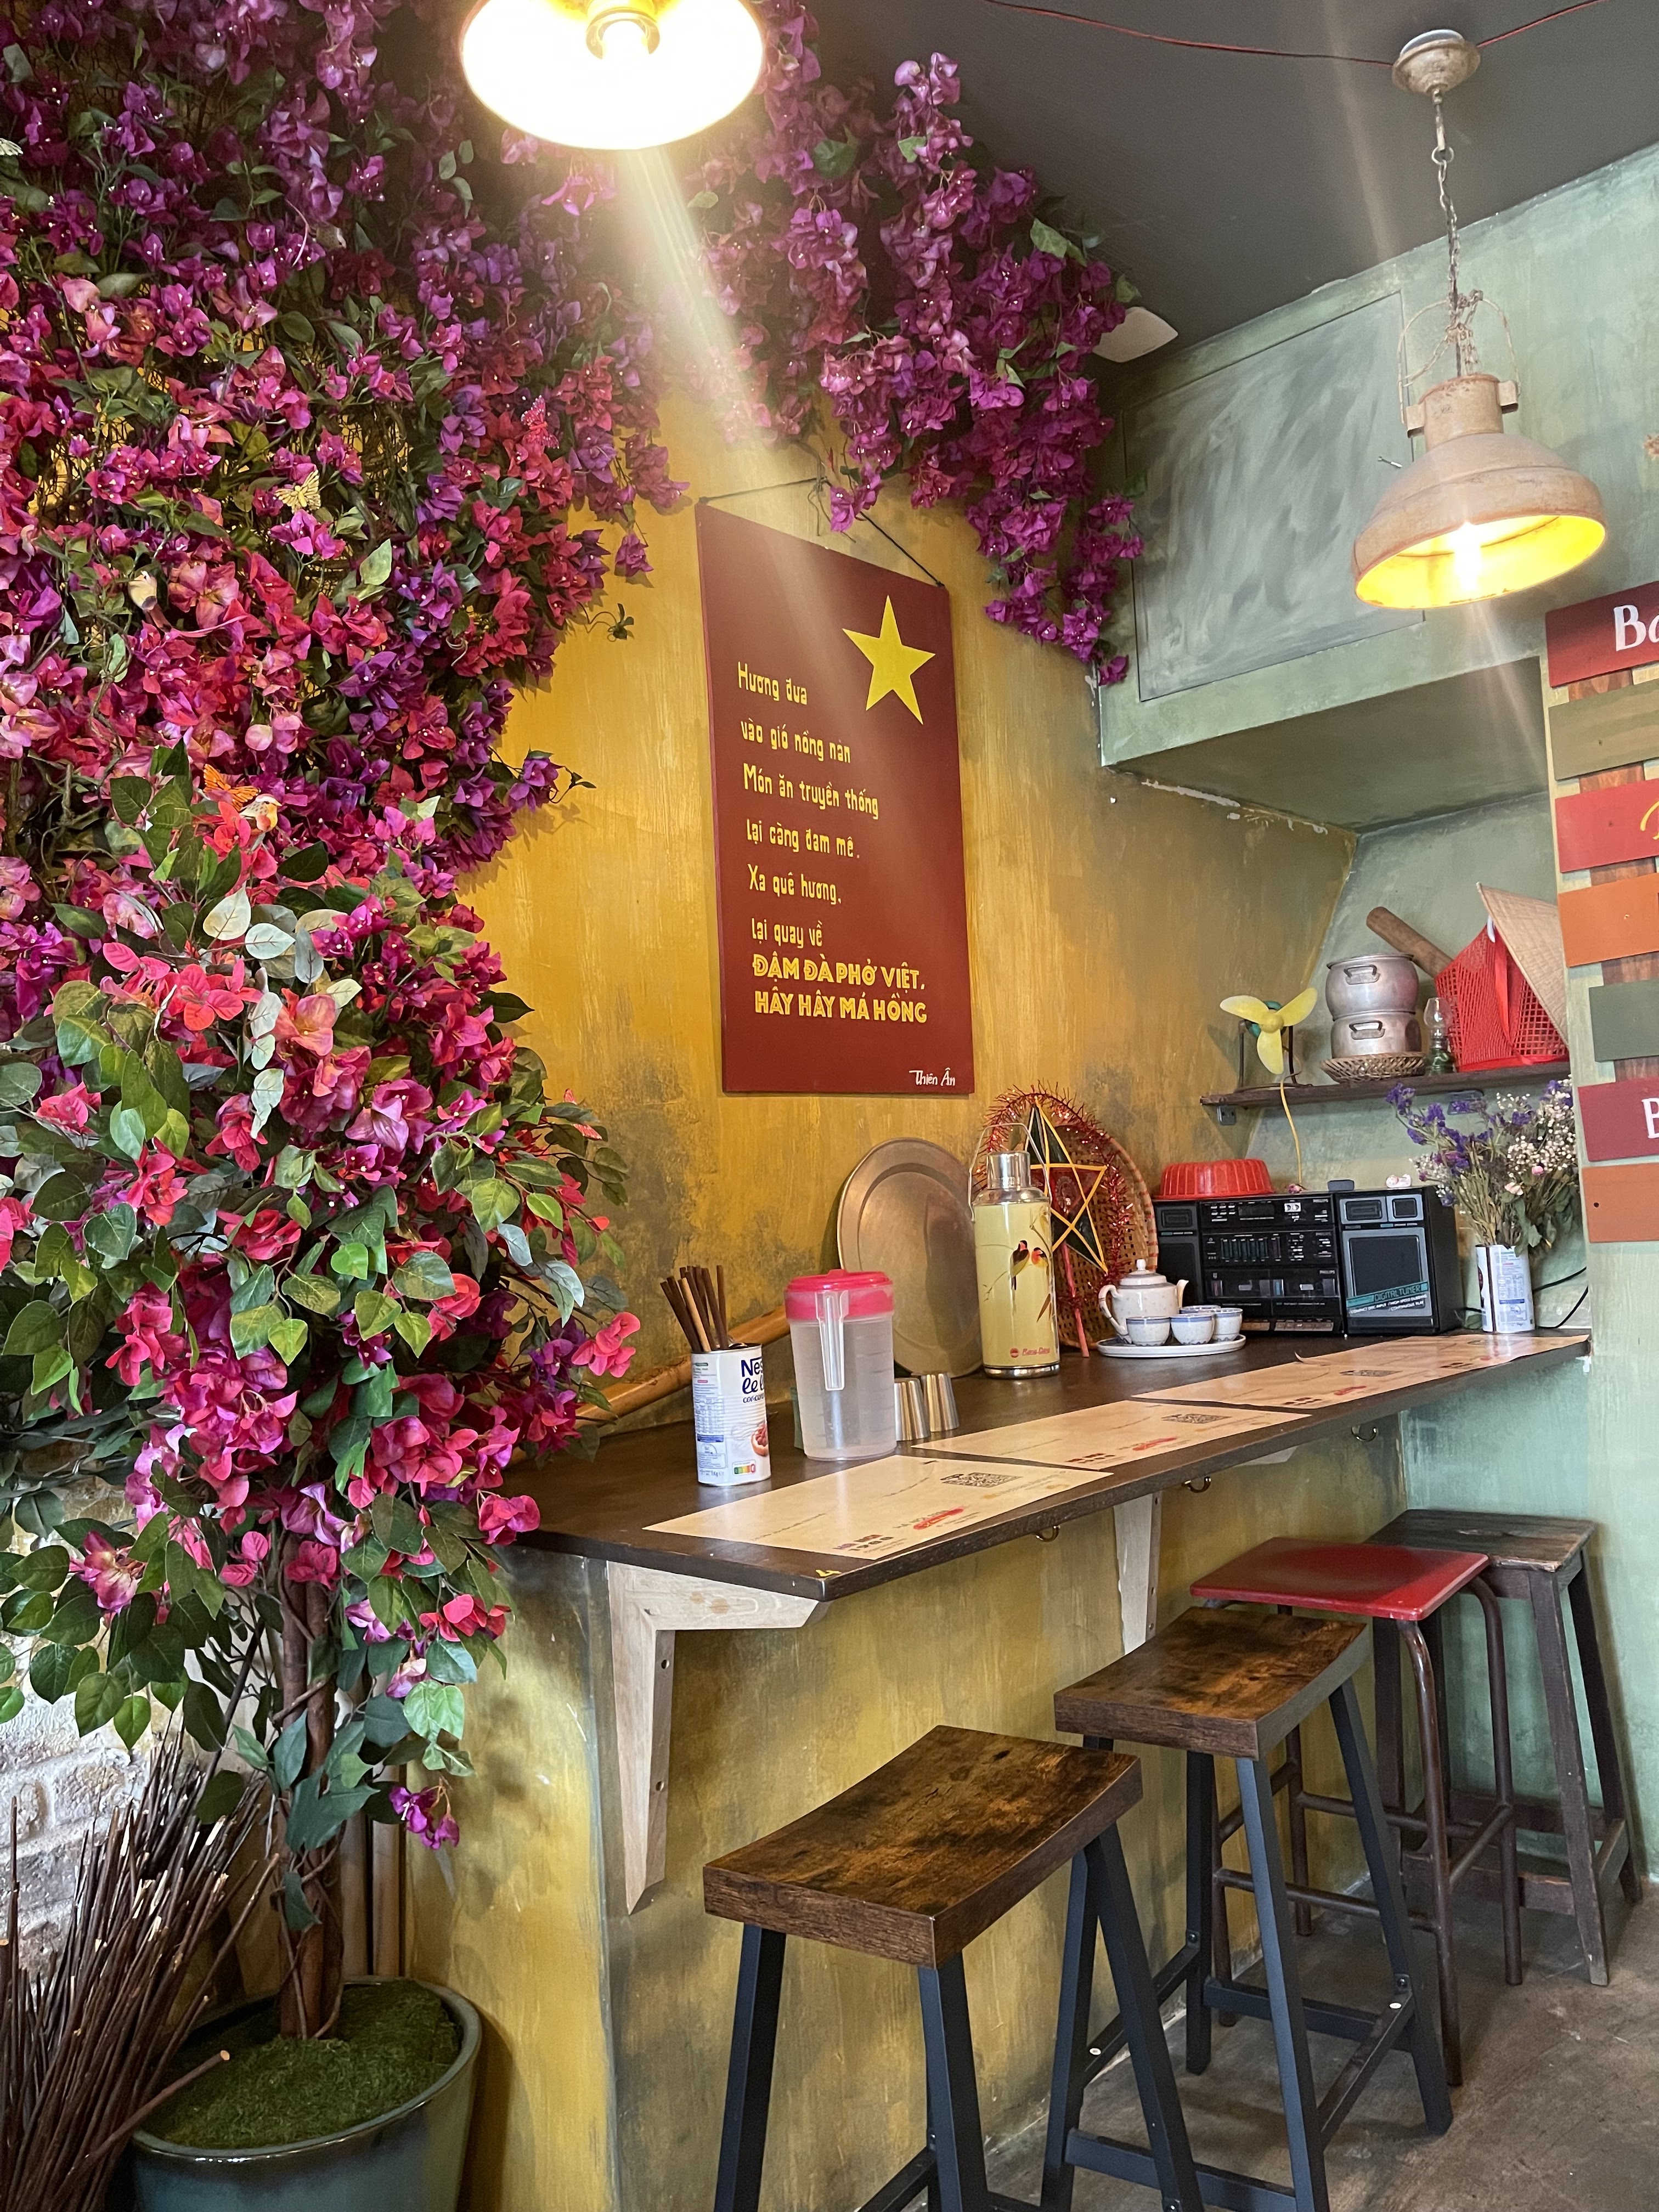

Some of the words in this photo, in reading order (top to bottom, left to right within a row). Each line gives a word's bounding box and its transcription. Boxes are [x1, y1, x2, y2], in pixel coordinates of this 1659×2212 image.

[738, 661, 780, 701] Hương
[786, 678, 808, 705] đưa
[740, 717, 763, 743] vào
[770, 724, 788, 750] gió
[794, 730, 824, 761] nồng
[829, 739, 850, 764] nàn
[743, 763, 772, 795] Món
[778, 773, 793, 799] ăn
[799, 780, 839, 810] truyền
[844, 788, 879, 820] thống
[769, 822, 799, 853] càng
[805, 828, 830, 854] đam
[747, 864, 766, 891] Xa
[772, 871, 794, 897] quê
[774, 924, 804, 949] quay
[808, 920, 823, 947] về
[752, 951, 800, 983] ĐẬM
[803, 953, 835, 983] ĐÀ
[836, 958, 878, 986] PHỞ
[754, 986, 794, 1015] HÂY
[798, 989, 836, 1018] HÂY
[839, 991, 870, 1020] MÁ
[873, 992, 927, 1023] HỒNG
[1374, 1290, 1399, 1302] DIGITAL
[1399, 1284, 1421, 1297] TUNER
[742, 1378, 758, 1394] le
